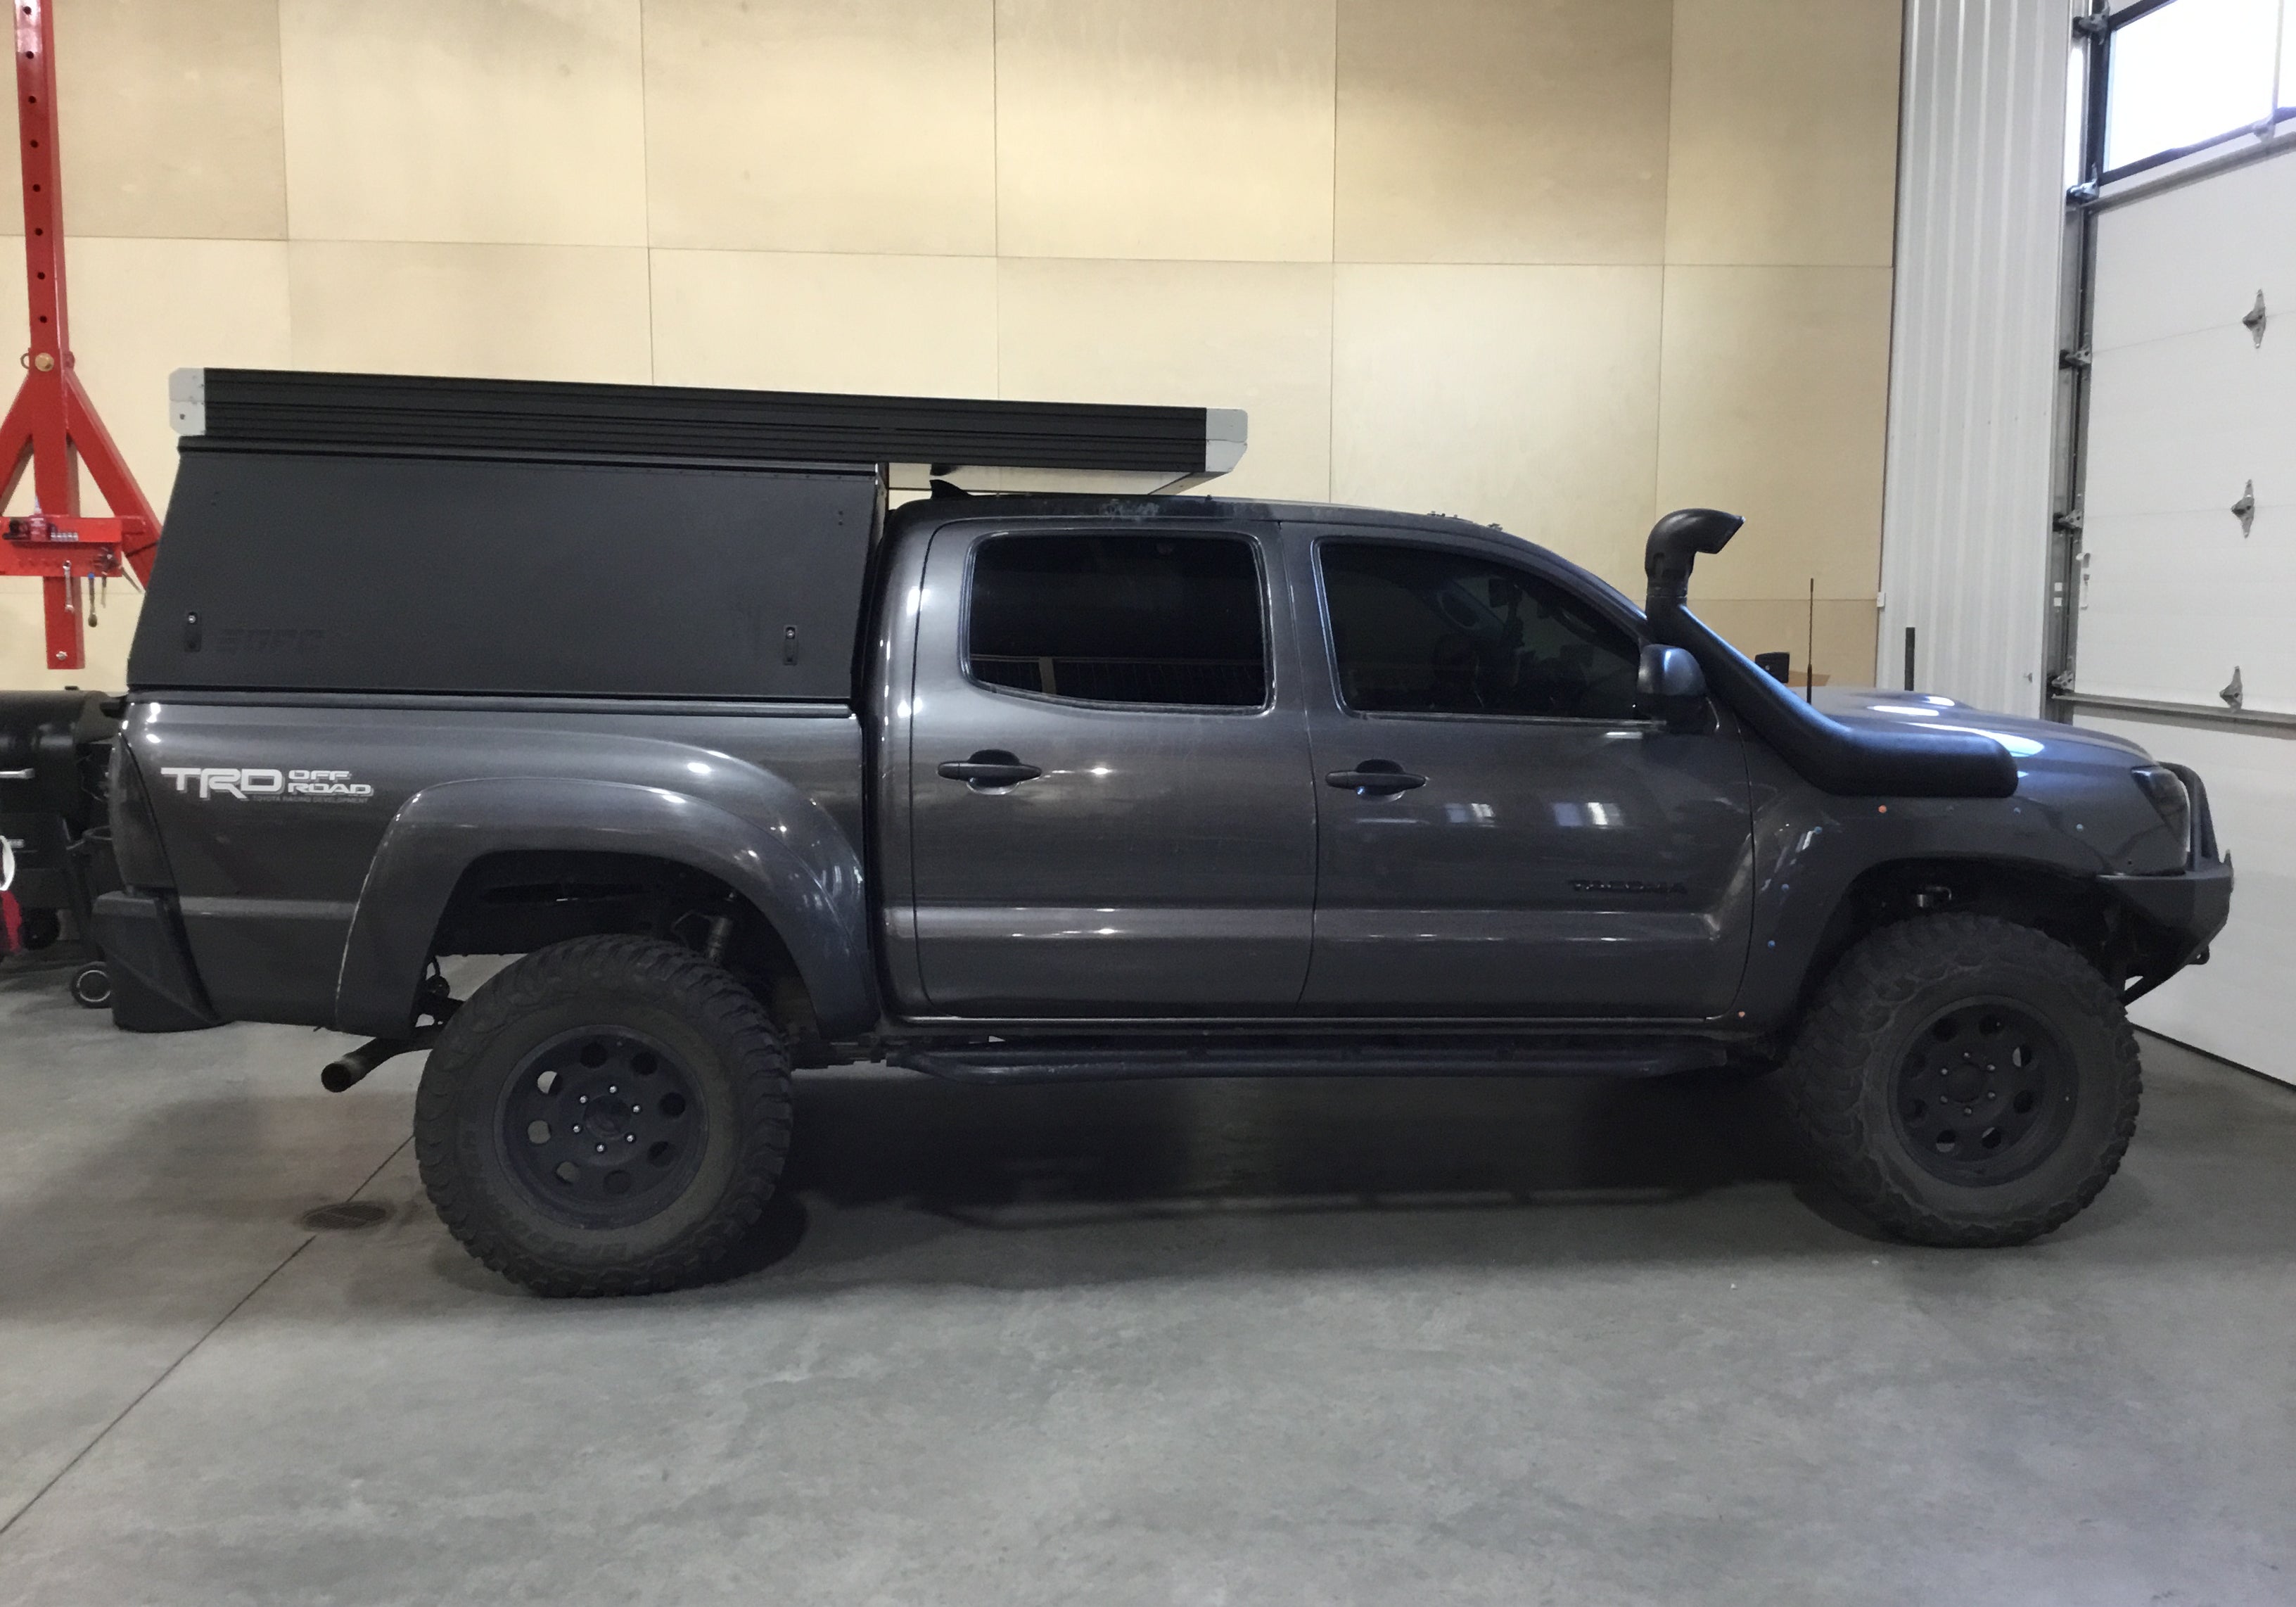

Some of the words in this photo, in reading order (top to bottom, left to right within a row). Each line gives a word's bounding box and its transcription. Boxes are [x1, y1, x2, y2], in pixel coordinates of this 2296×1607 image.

[288, 769, 351, 782] OFF
[160, 767, 284, 800] TRD
[288, 782, 374, 796] ROAD
